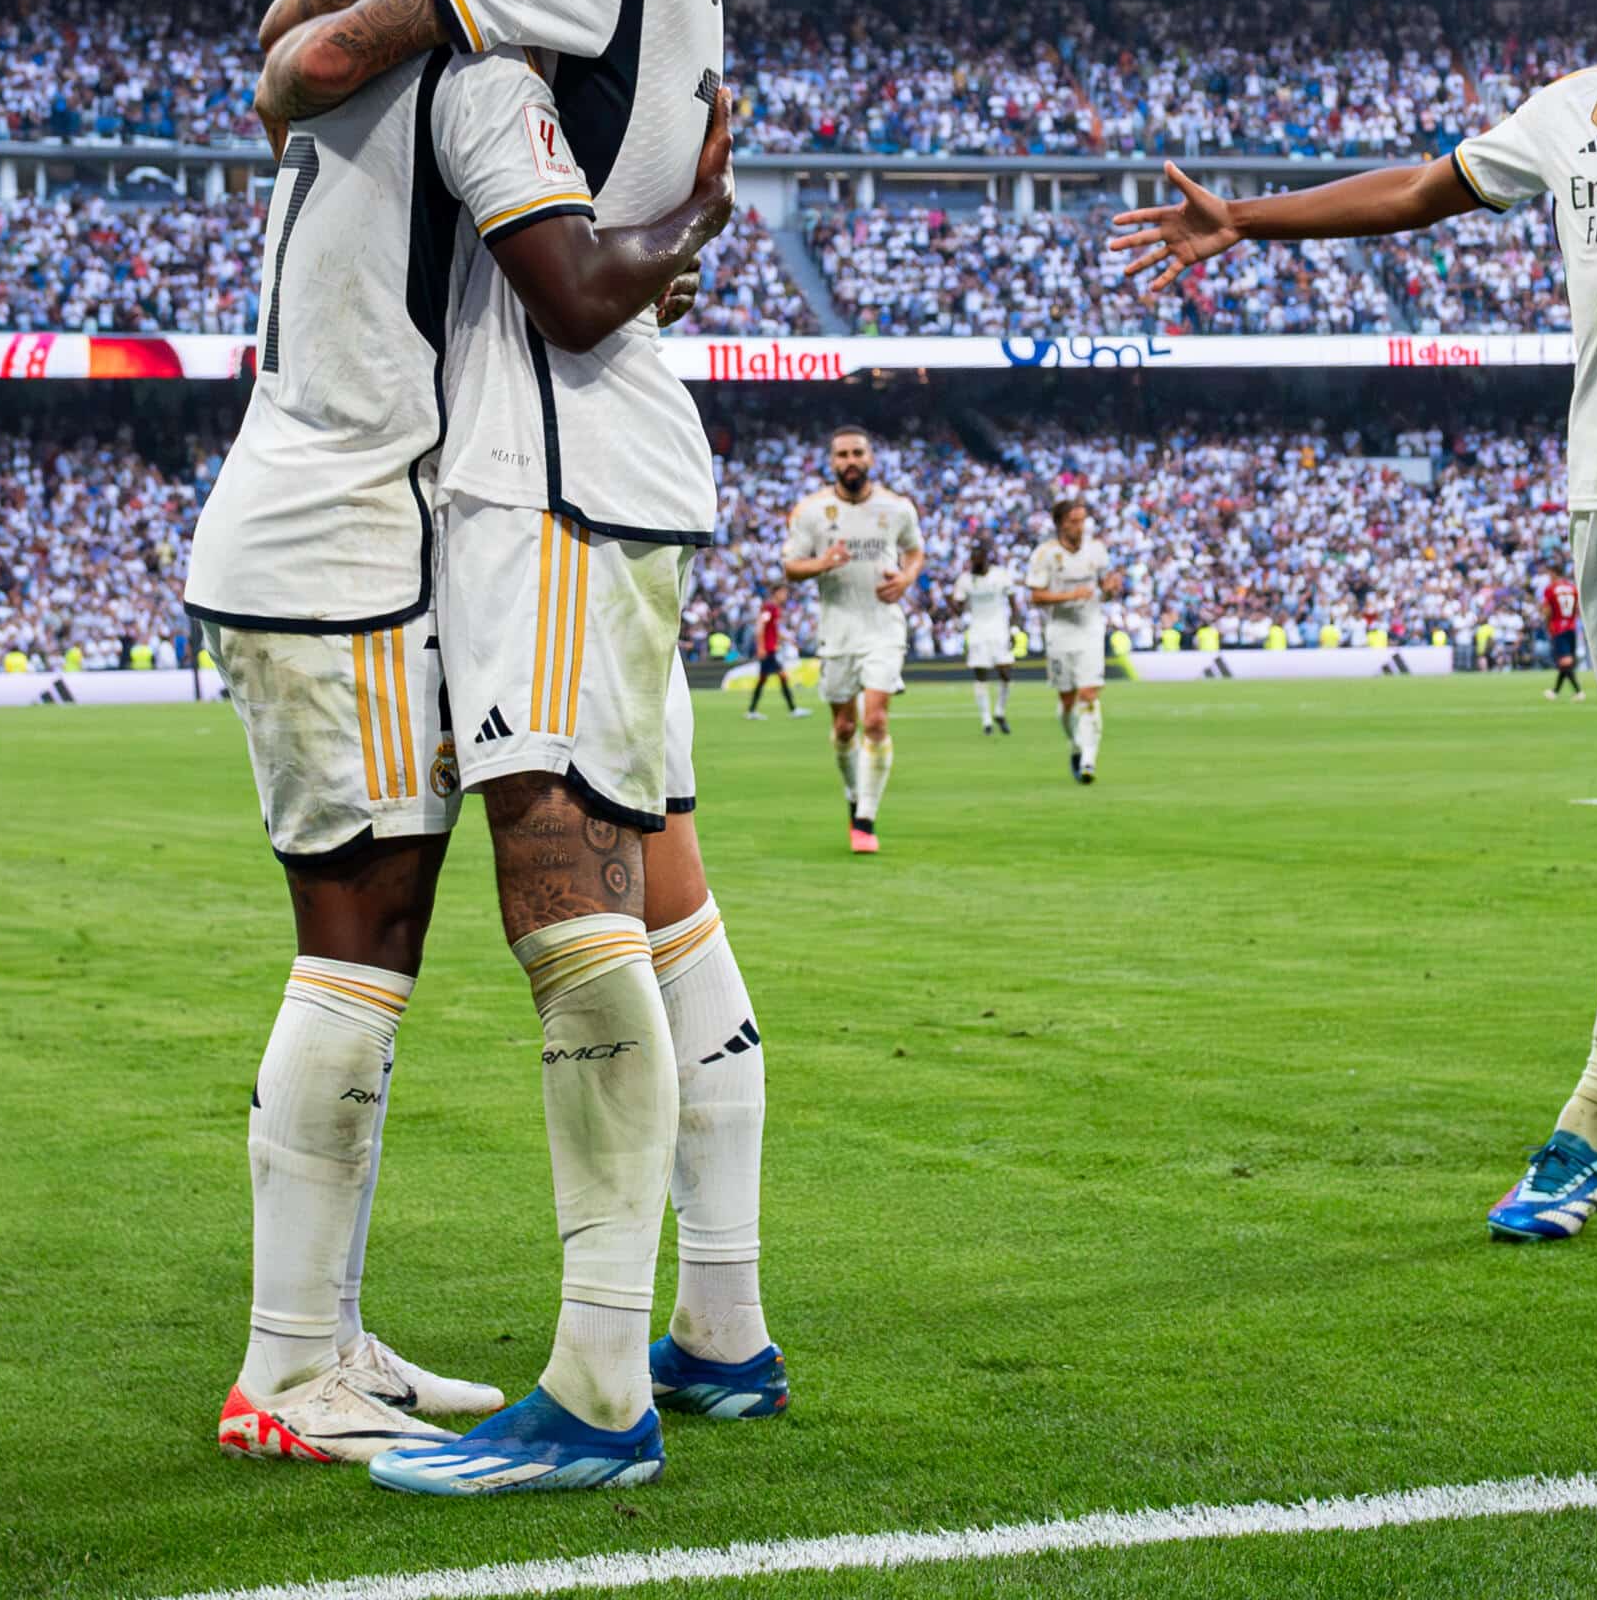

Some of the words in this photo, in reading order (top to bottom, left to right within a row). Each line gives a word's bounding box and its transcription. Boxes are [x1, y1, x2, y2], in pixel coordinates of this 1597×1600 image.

[261, 136, 320, 374] 7
[708, 338, 844, 381] Mahou
[1388, 336, 1481, 367] Mahou
[541, 1040, 638, 1064] RMCF
